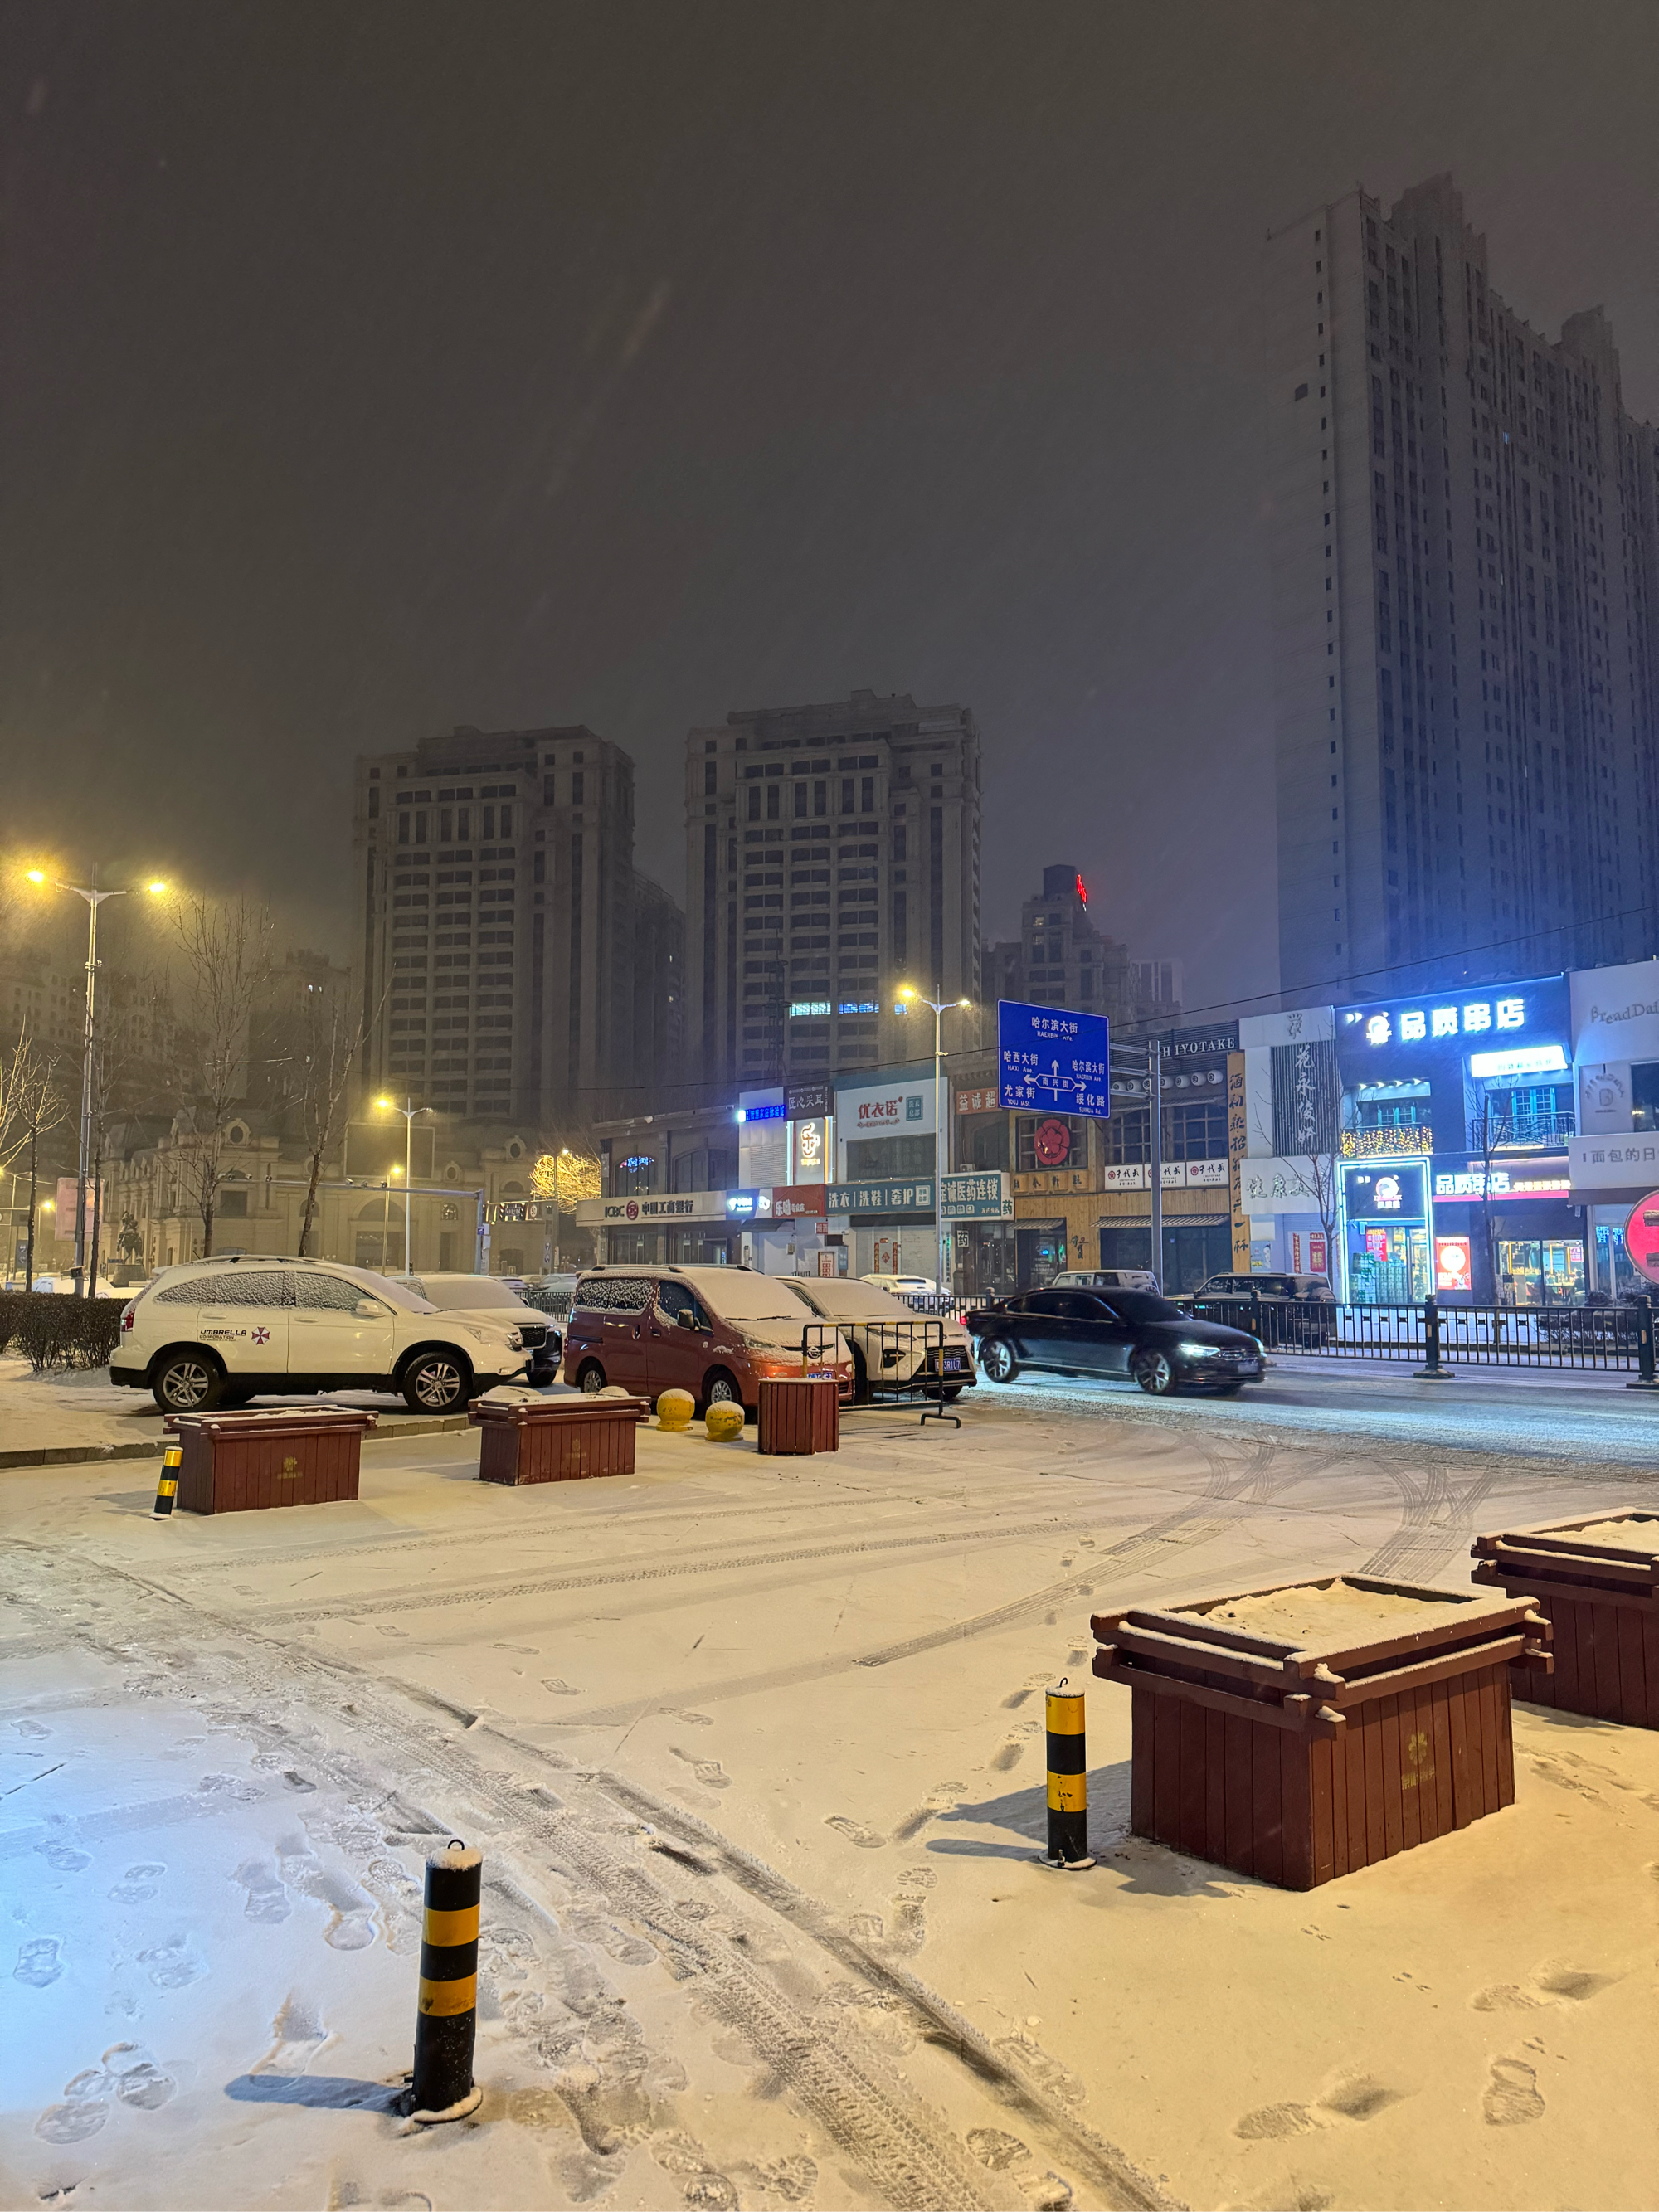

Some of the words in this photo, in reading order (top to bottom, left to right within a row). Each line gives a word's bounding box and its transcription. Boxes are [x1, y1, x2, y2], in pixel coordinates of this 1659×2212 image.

[1031, 1016, 1078, 1033] 哈尔滨大街
[1400, 999, 1525, 1040] 品质串店
[1037, 1031, 1058, 1039] HAERBIN
[1003, 1050, 1039, 1066] 哈西大街
[1072, 1059, 1105, 1075] 哈尔滨大街
[1042, 1077, 1069, 1088] 南兴街
[1004, 1084, 1035, 1099] 尤家街
[1076, 1092, 1105, 1107] 绥化路
[788, 1094, 824, 1110] 匠心采耳
[959, 1091, 996, 1111] 益诚超
[858, 1100, 898, 1120] 优衣诺
[1590, 1147, 1659, 1164] 面包的日
[1436, 1172, 1510, 1195] 品质串店
[829, 1191, 851, 1208] 洗衣
[859, 1189, 883, 1207] 洗鞋
[890, 1188, 914, 1205] 奢护
[604, 1205, 625, 1218] ICBC
[641, 1199, 693, 1216] 中国工商银行
[1002, 1199, 1013, 1215] 药
[957, 1231, 969, 1247] 药
